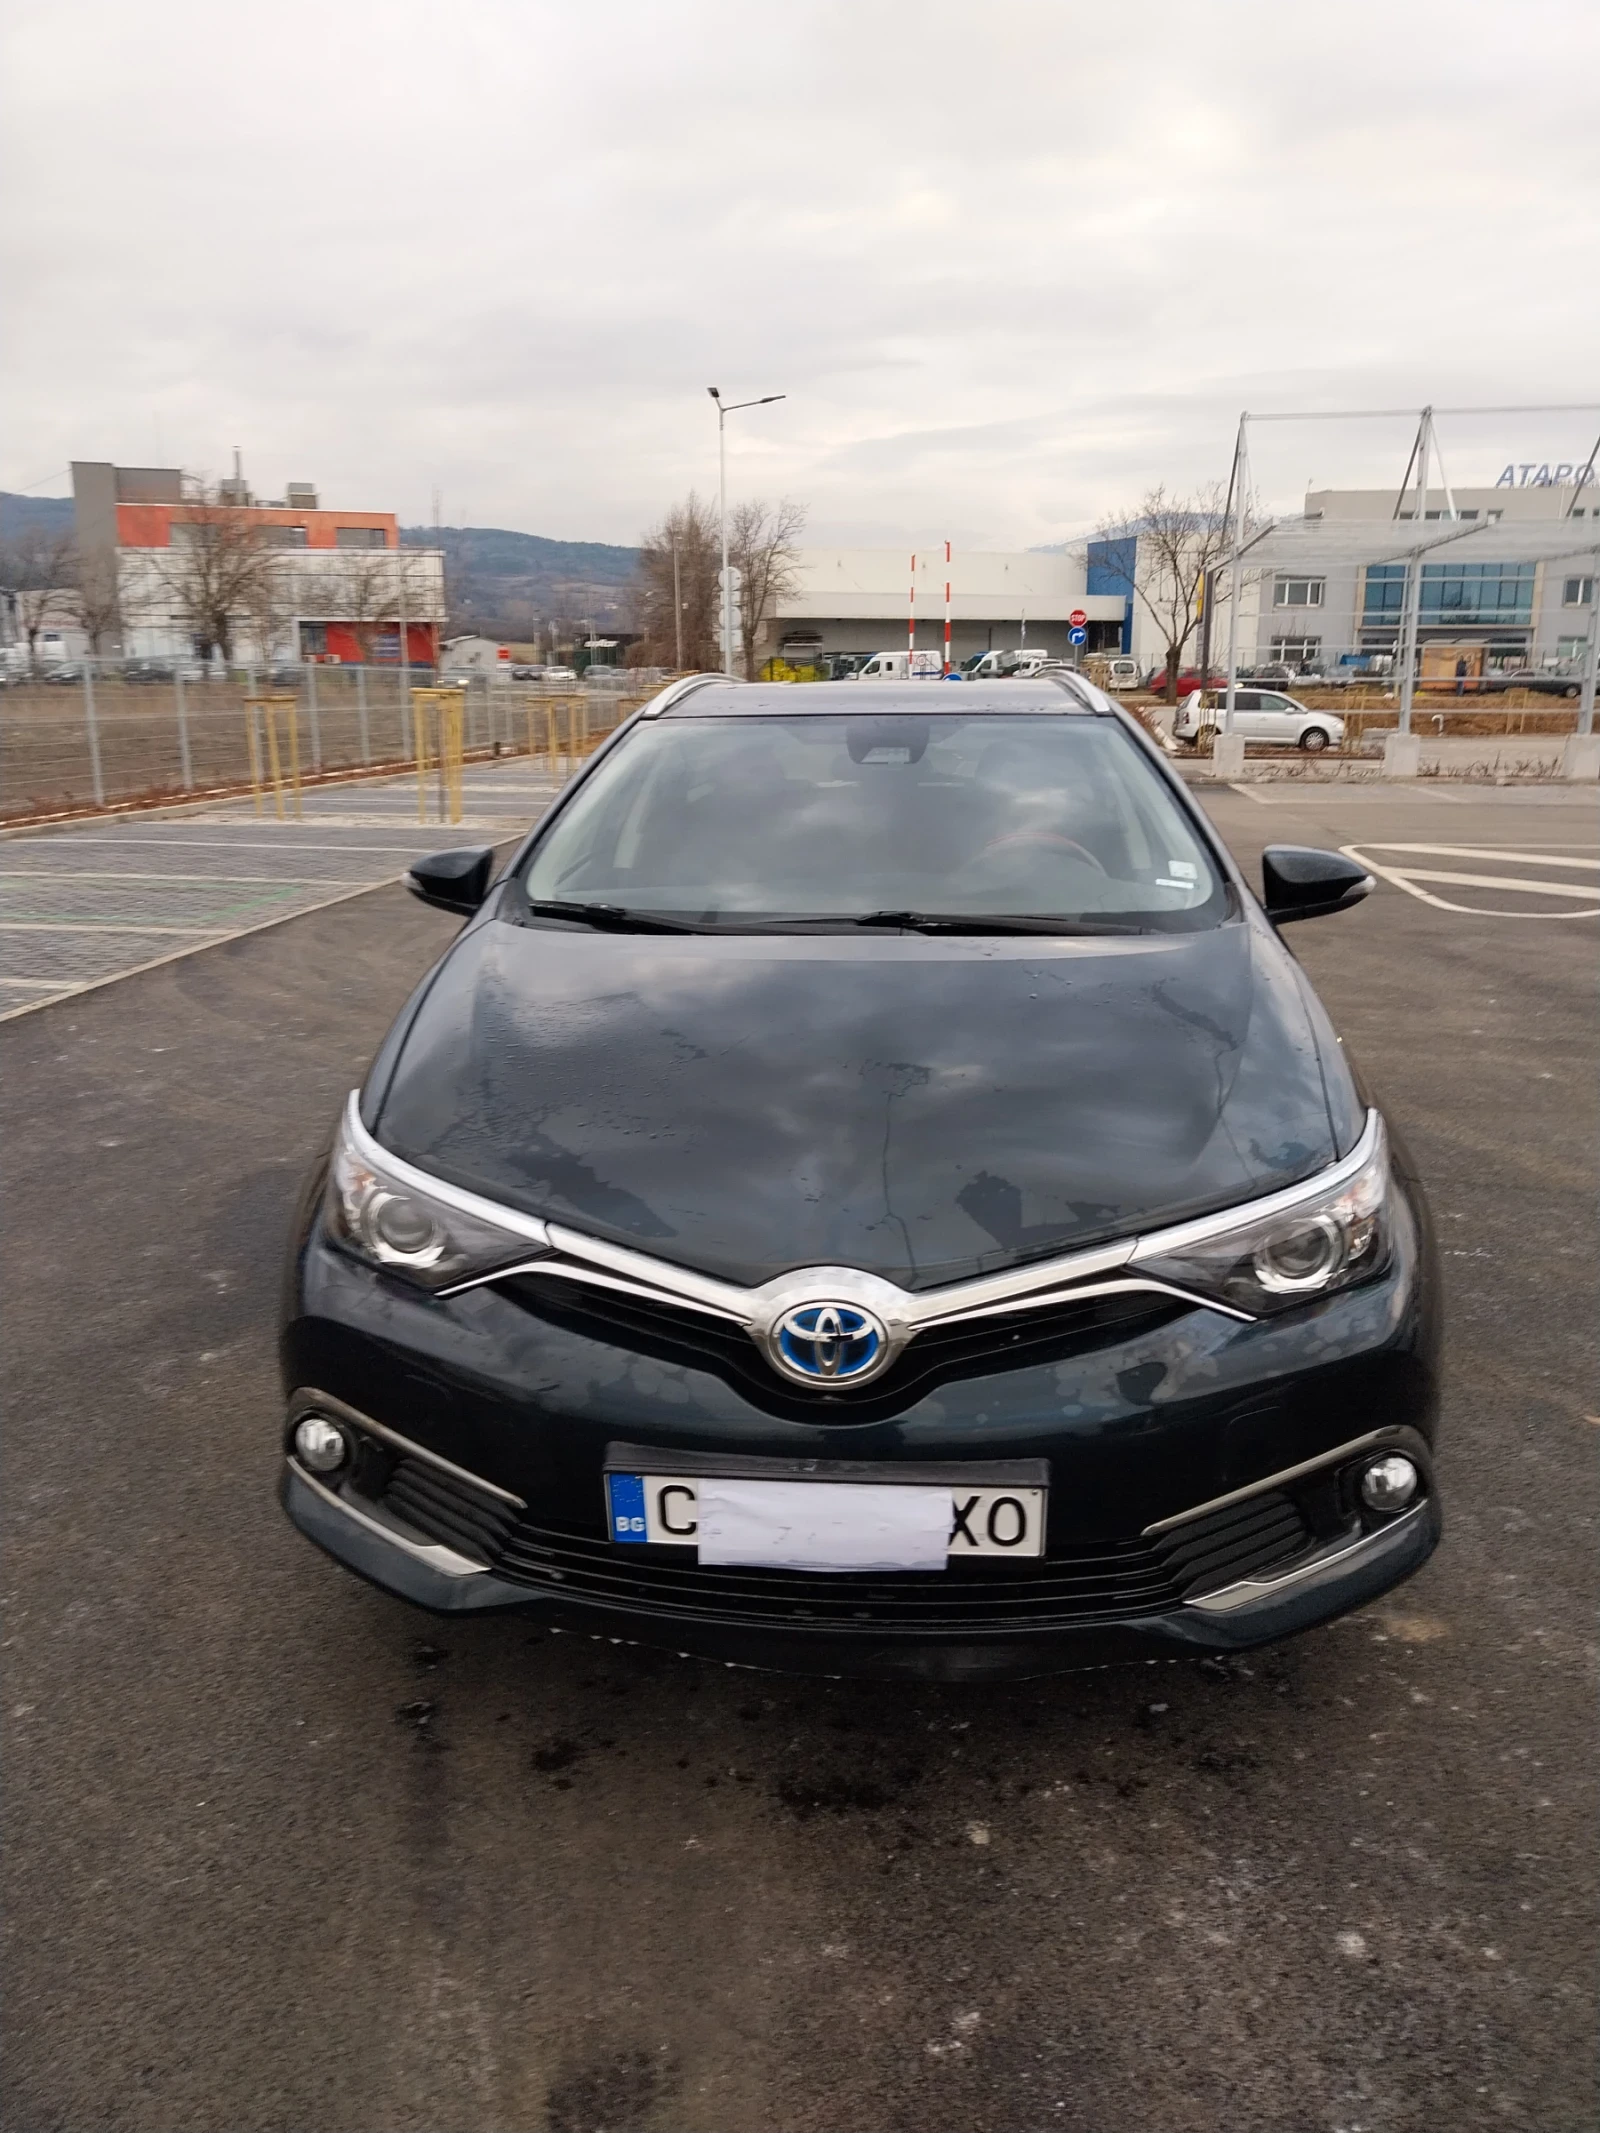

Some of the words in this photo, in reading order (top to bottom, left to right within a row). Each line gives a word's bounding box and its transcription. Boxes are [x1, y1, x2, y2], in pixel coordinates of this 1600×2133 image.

[1071, 614, 1086, 622] STOP
[658, 1484, 697, 1536] C
[948, 1495, 1026, 1547] XO
[616, 1516, 645, 1532] BG
